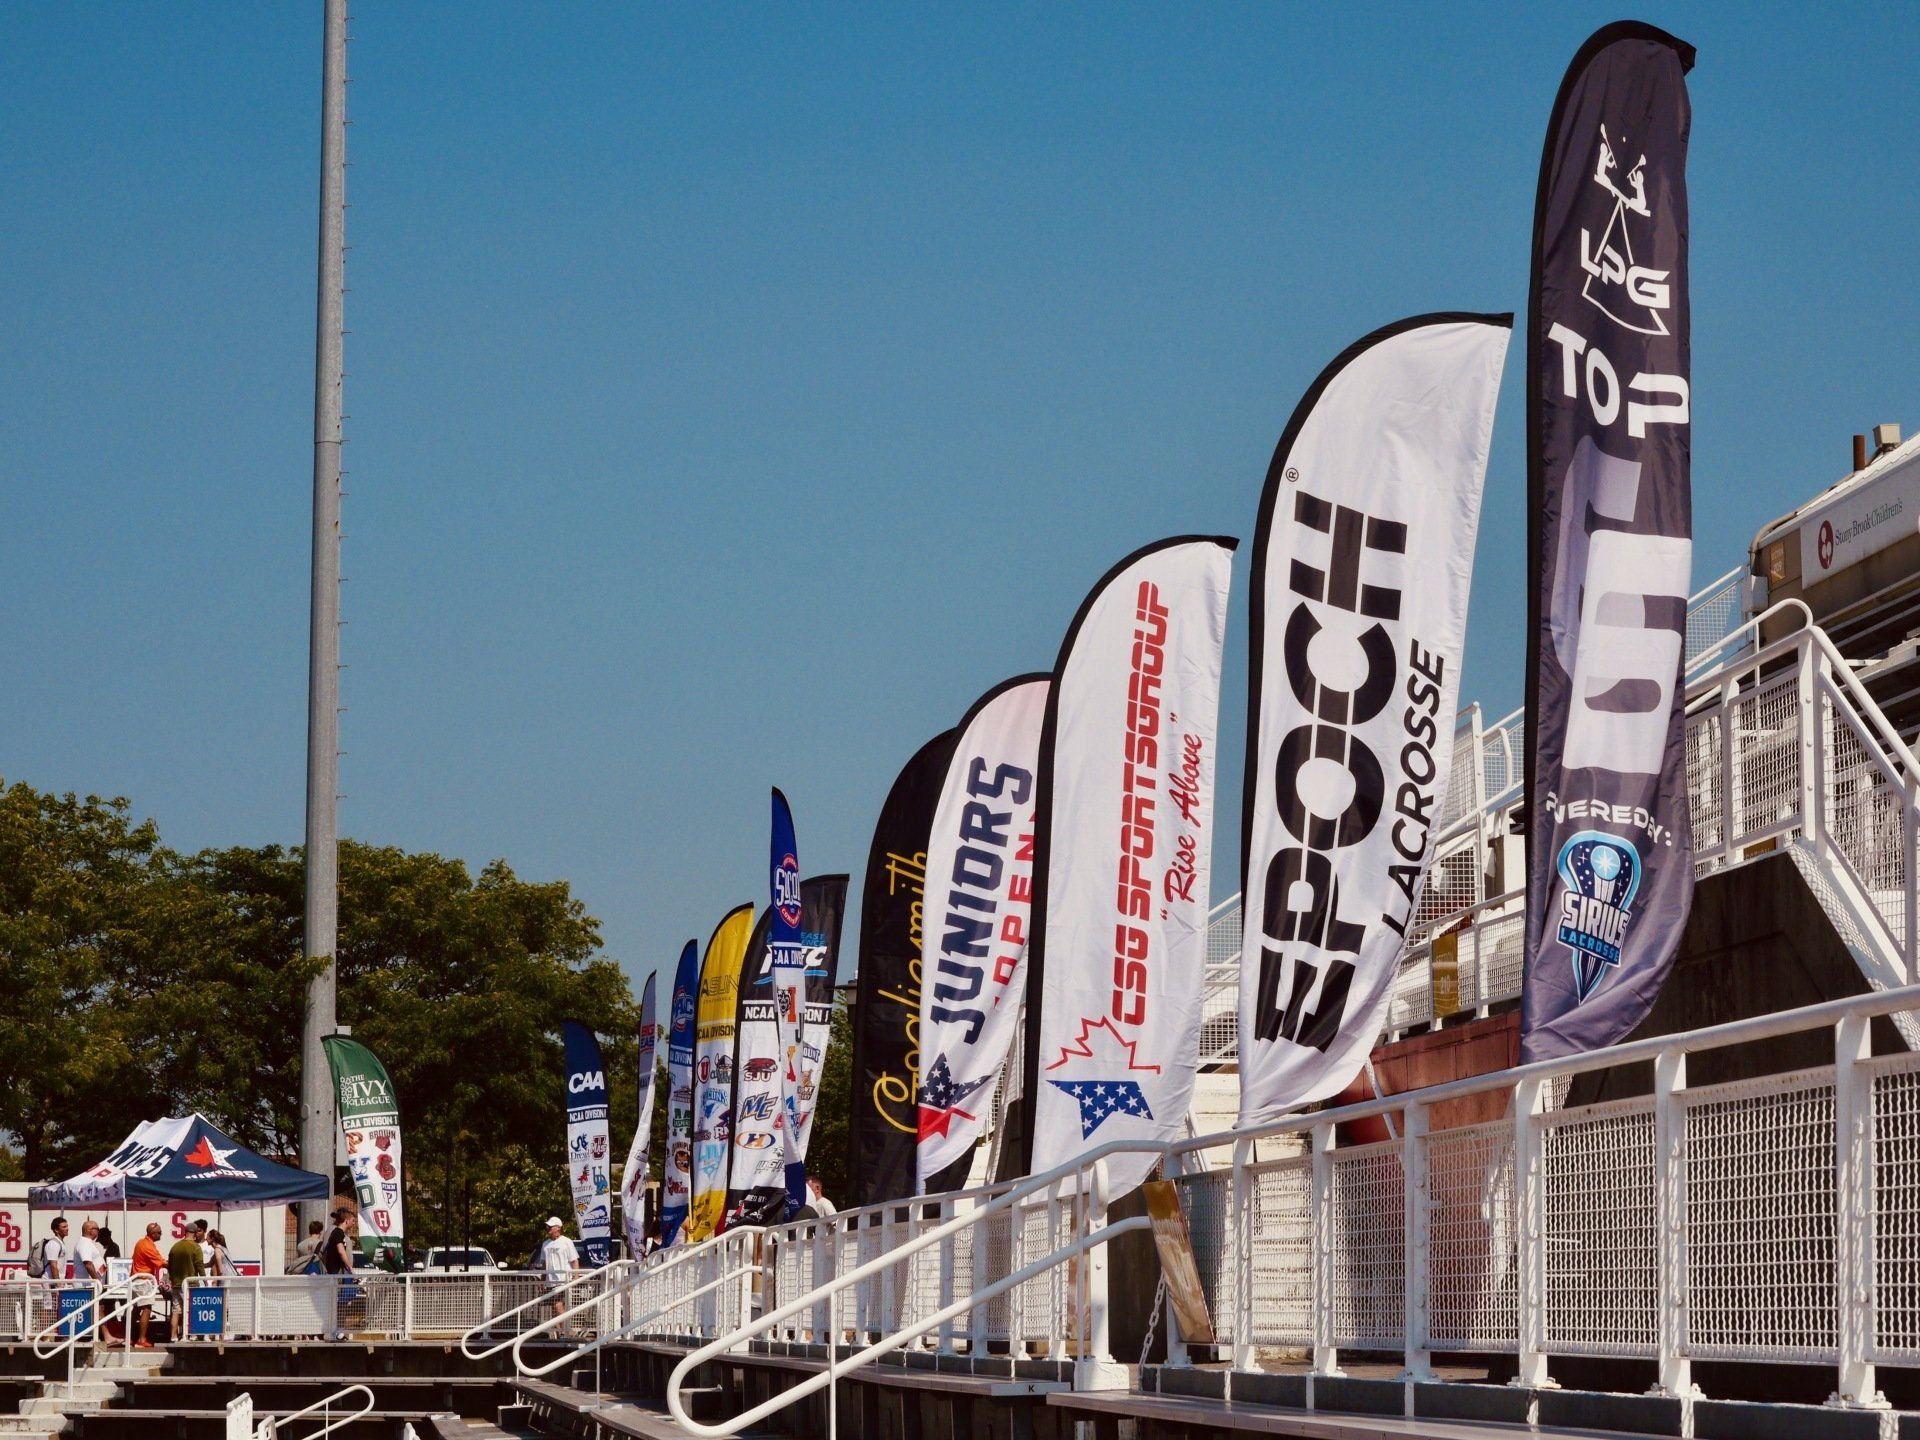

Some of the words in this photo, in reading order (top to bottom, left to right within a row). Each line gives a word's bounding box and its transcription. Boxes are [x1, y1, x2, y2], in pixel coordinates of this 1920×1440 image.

[1581, 227, 1670, 309] LPG
[1548, 322, 1690, 439] TOP
[1835, 527, 1853, 546] Stony
[1853, 513, 1871, 537] Brook
[1117, 580, 1171, 923] SPORTSGROUP
[1255, 489, 1409, 1055] EPOCH
[1381, 638, 1447, 940] LACROSSE
[929, 756, 1033, 1045] JUNIORS
[1561, 891, 1631, 949] SIRIUS
[1559, 927, 1620, 964] LACROSSE
[745, 1006, 775, 1020] NCAA
[350, 1074, 365, 1082] THE
[351, 1079, 387, 1099] IVY
[568, 1070, 605, 1094] CAA
[743, 1072, 771, 1083] SJU
[354, 1096, 391, 1107] LEAGUE
[739, 1091, 779, 1122] MC
[369, 1130, 397, 1140] BROWN
[357, 1184, 375, 1209] D
[377, 1211, 388, 1227] H
[192, 1296, 223, 1306] SECTION
[198, 1310, 216, 1322] 108
